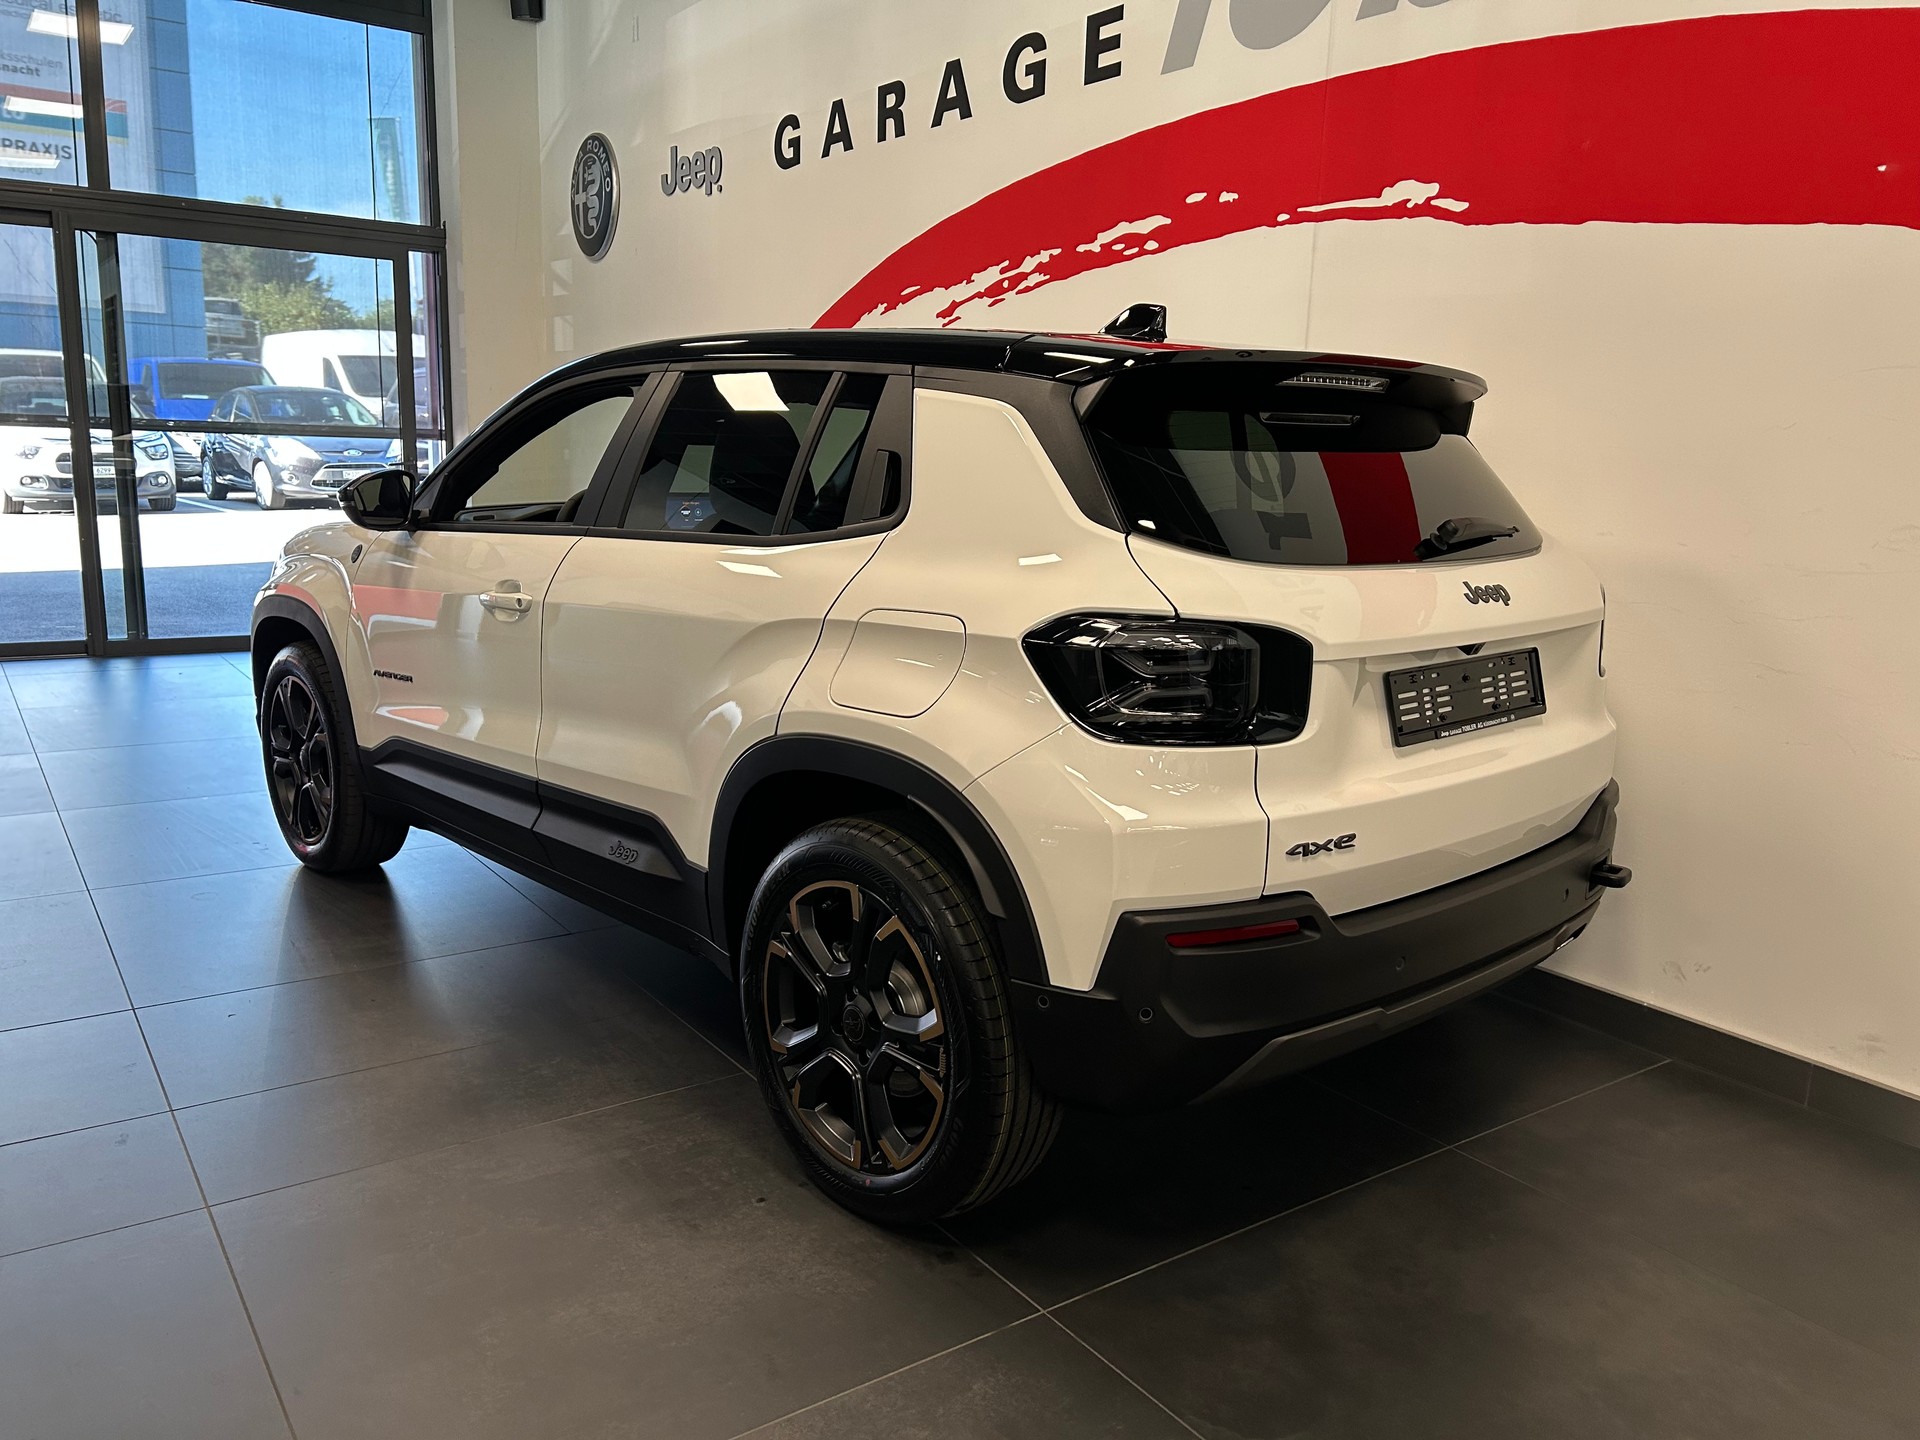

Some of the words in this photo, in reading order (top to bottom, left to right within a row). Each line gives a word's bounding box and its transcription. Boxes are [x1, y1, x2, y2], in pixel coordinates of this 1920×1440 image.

[0, 63, 41, 77] nacht
[774, 3, 1125, 170] GARAGE
[586, 139, 612, 192] ROMEO
[661, 145, 723, 196] Jeep
[1462, 581, 1511, 606] Jeep
[373, 669, 414, 683] AVENGER
[608, 840, 639, 864] Jeep
[1285, 833, 1356, 857] 4xe
